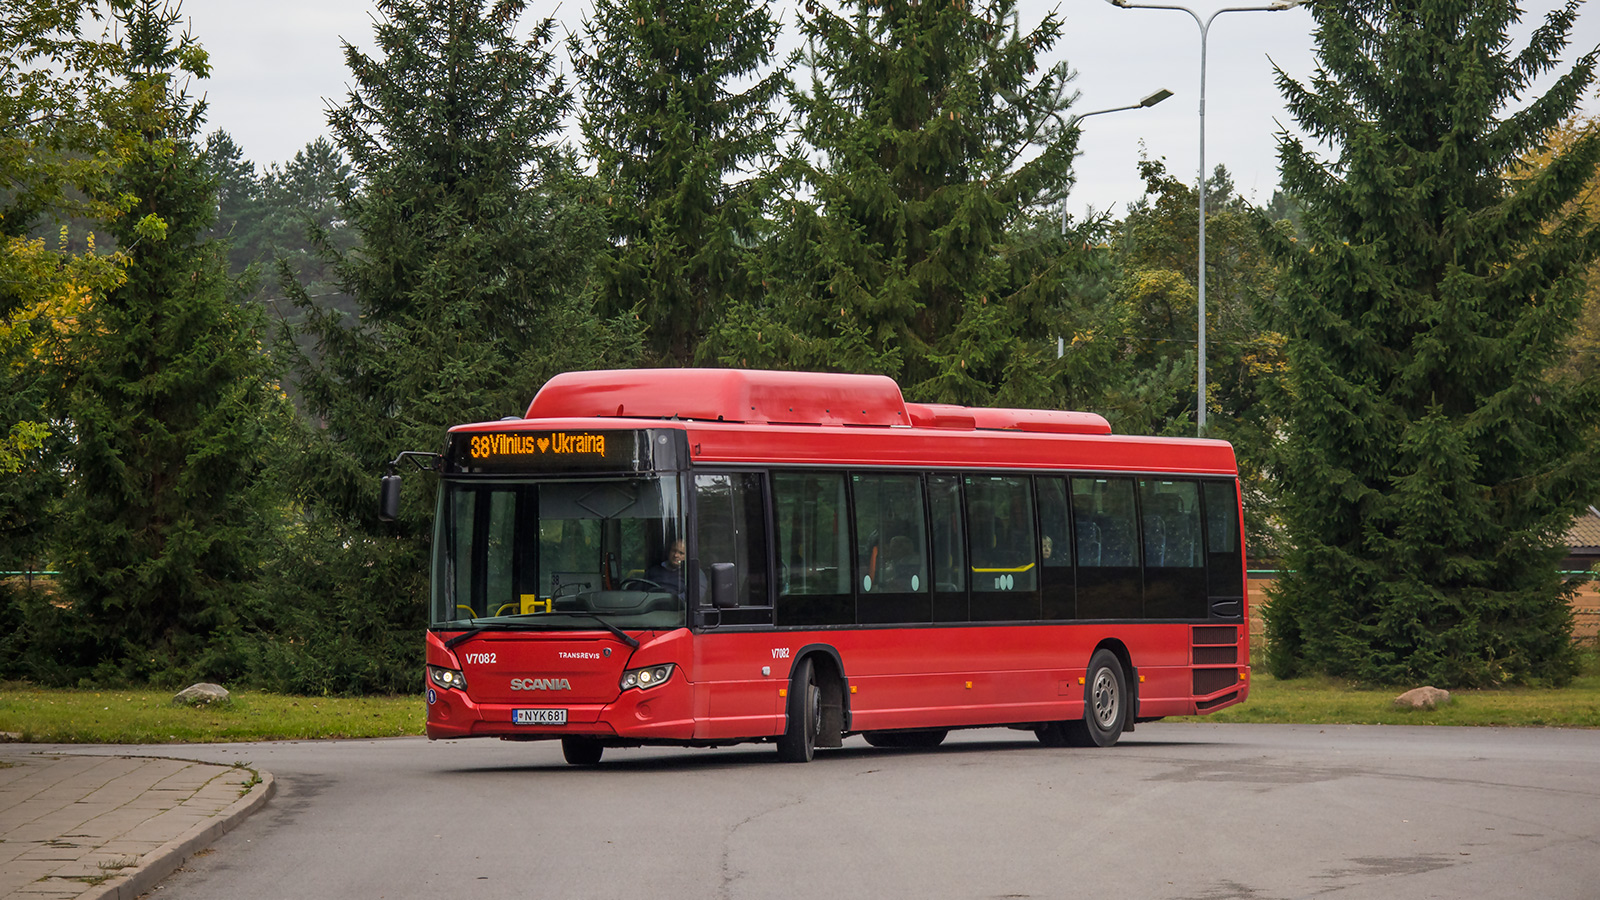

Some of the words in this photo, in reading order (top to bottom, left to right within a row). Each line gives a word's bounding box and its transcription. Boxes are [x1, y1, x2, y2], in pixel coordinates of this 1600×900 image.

[470, 436, 490, 458] 38
[489, 433, 535, 455] Vilnius
[552, 432, 605, 457] Ukrainą
[465, 653, 497, 664] V7082
[771, 647, 790, 659] V7082
[510, 678, 572, 691] SCANIA
